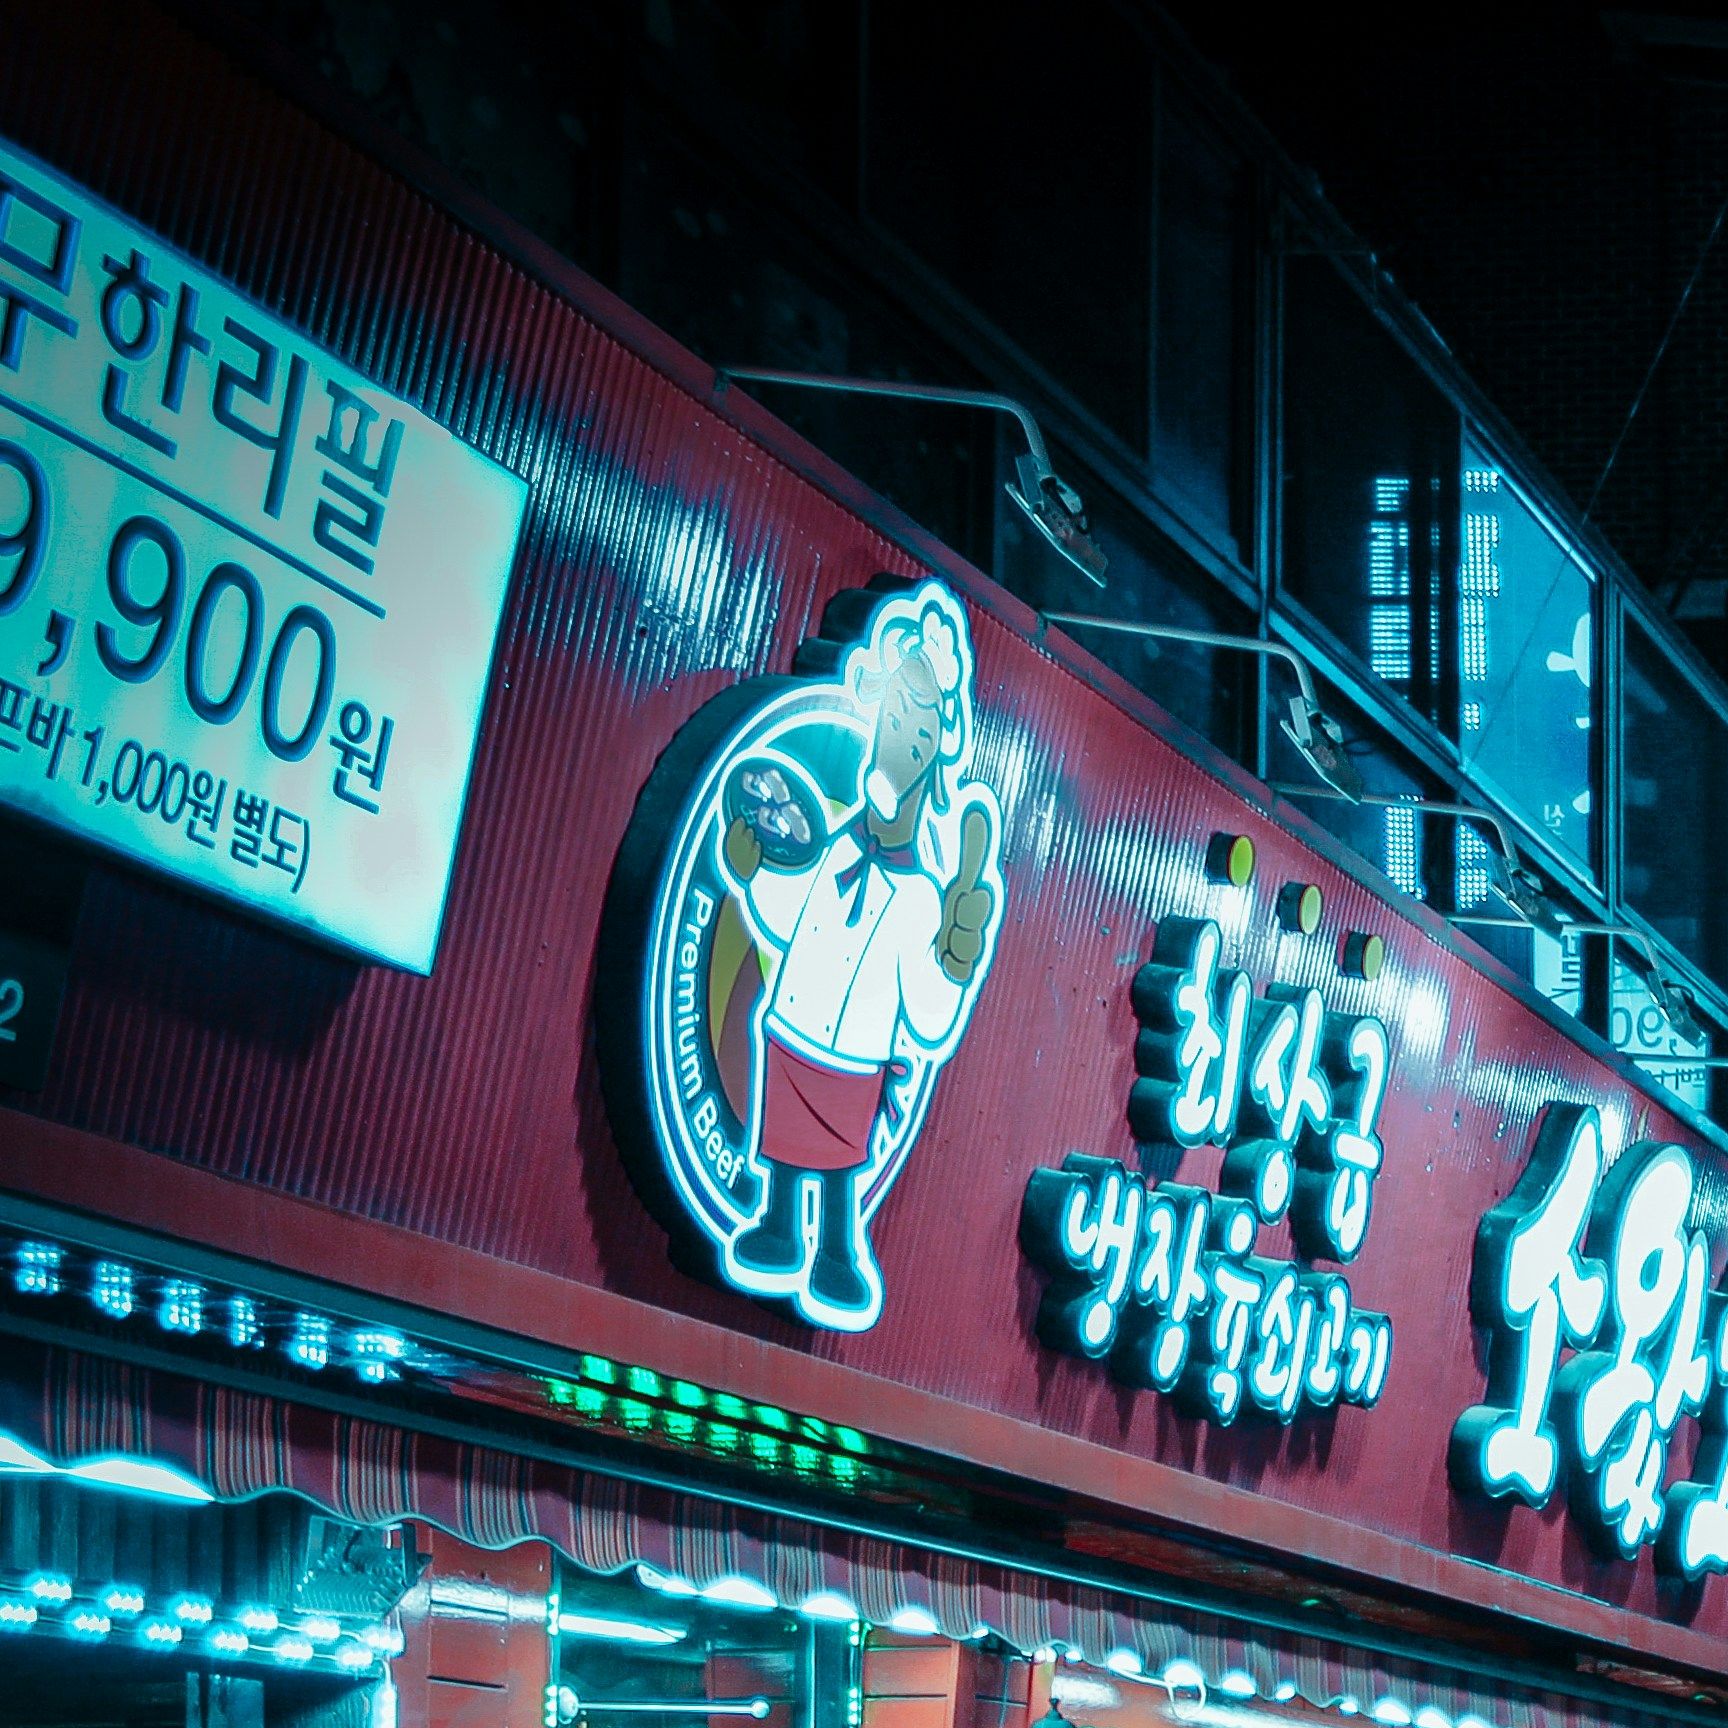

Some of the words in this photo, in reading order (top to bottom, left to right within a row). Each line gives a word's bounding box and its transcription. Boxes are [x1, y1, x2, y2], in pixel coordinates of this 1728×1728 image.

[0, 184, 404, 577] 무한리필
[80, 725, 223, 846] 1,000원
[231, 793, 313, 893] 별도)
[672, 887, 713, 1101] Premium
[1174, 919, 1390, 1264] 최상급
[692, 1104, 745, 1192] Beef
